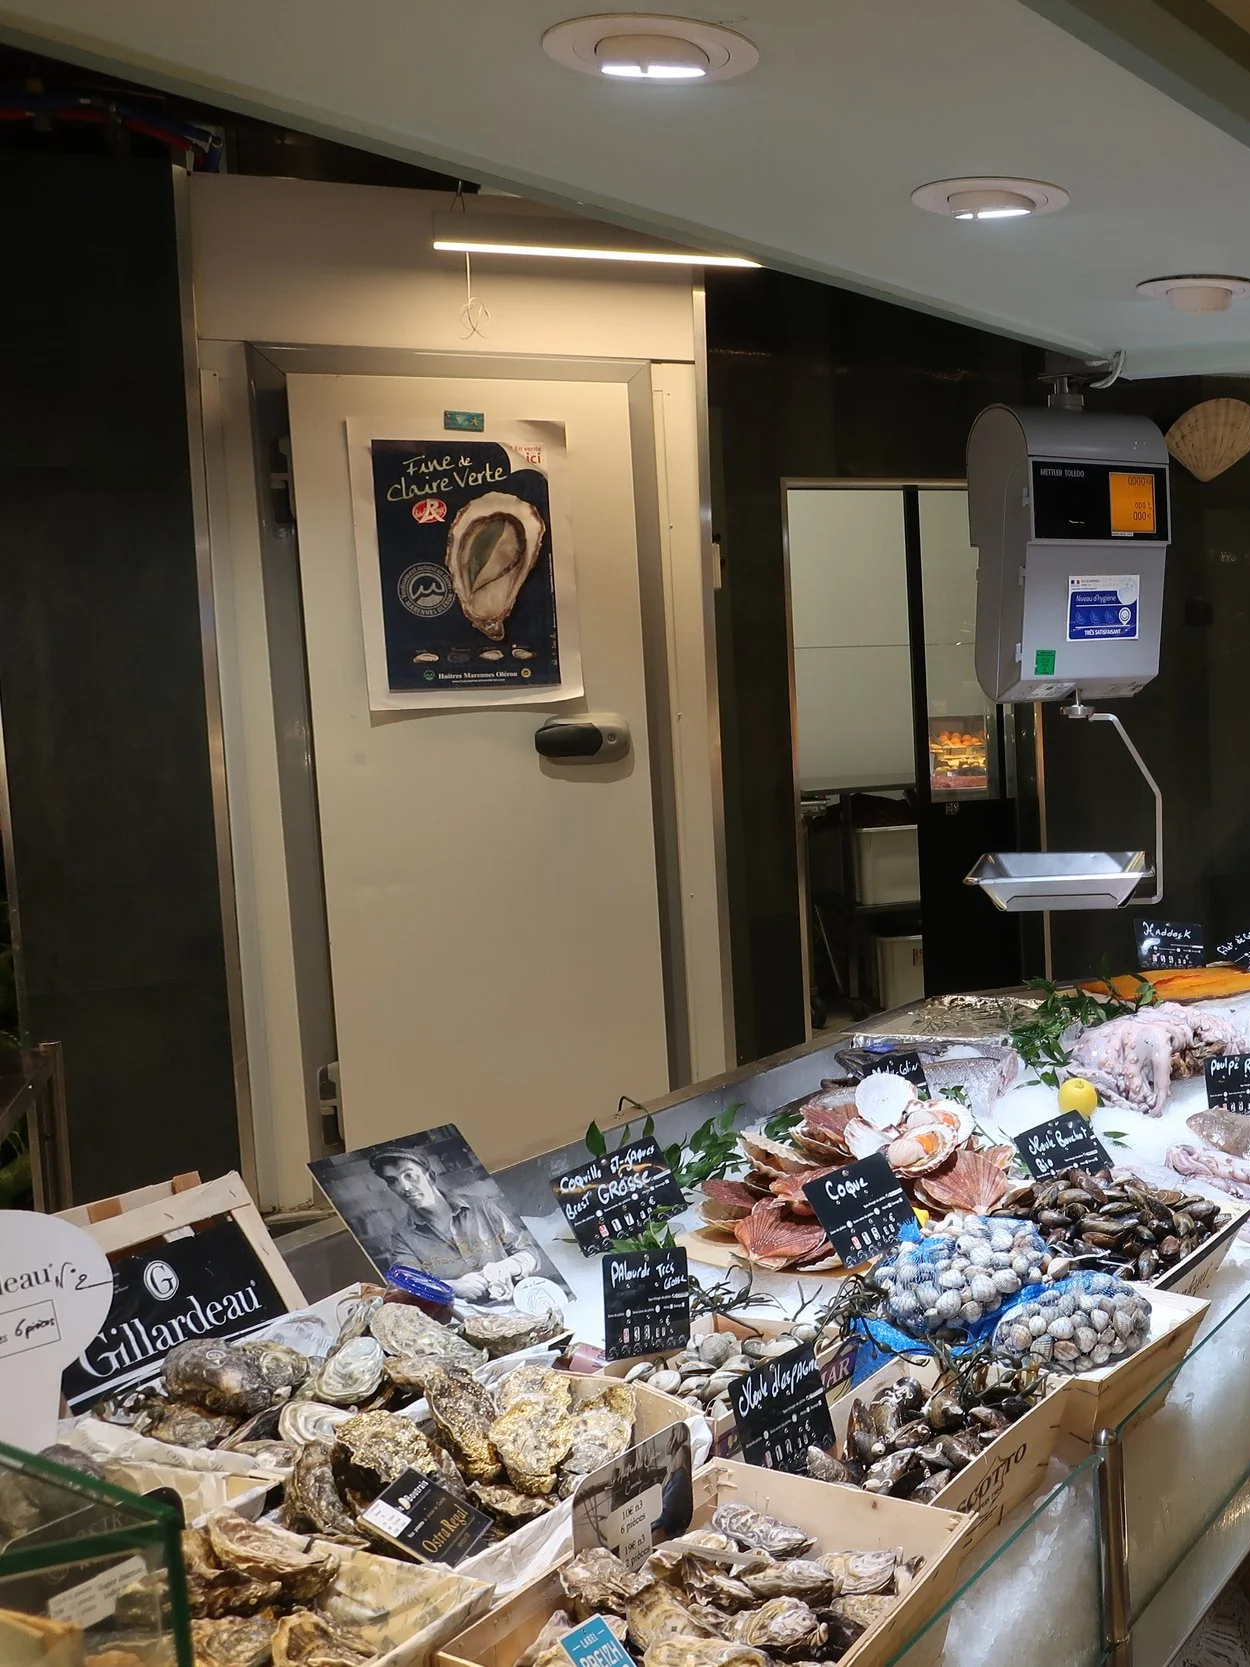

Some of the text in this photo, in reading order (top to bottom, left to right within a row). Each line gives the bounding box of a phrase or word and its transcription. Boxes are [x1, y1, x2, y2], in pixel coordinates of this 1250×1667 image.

[526, 452, 542, 464] ici
[402, 455, 472, 476] Fine de
[1040, 468, 1085, 478] METTLER TOLEDO
[387, 463, 508, 501] Claire Verte
[464, 671, 495, 679] Marennes
[496, 670, 518, 679] Oléron
[580, 1632, 599, 1649] LABEL
